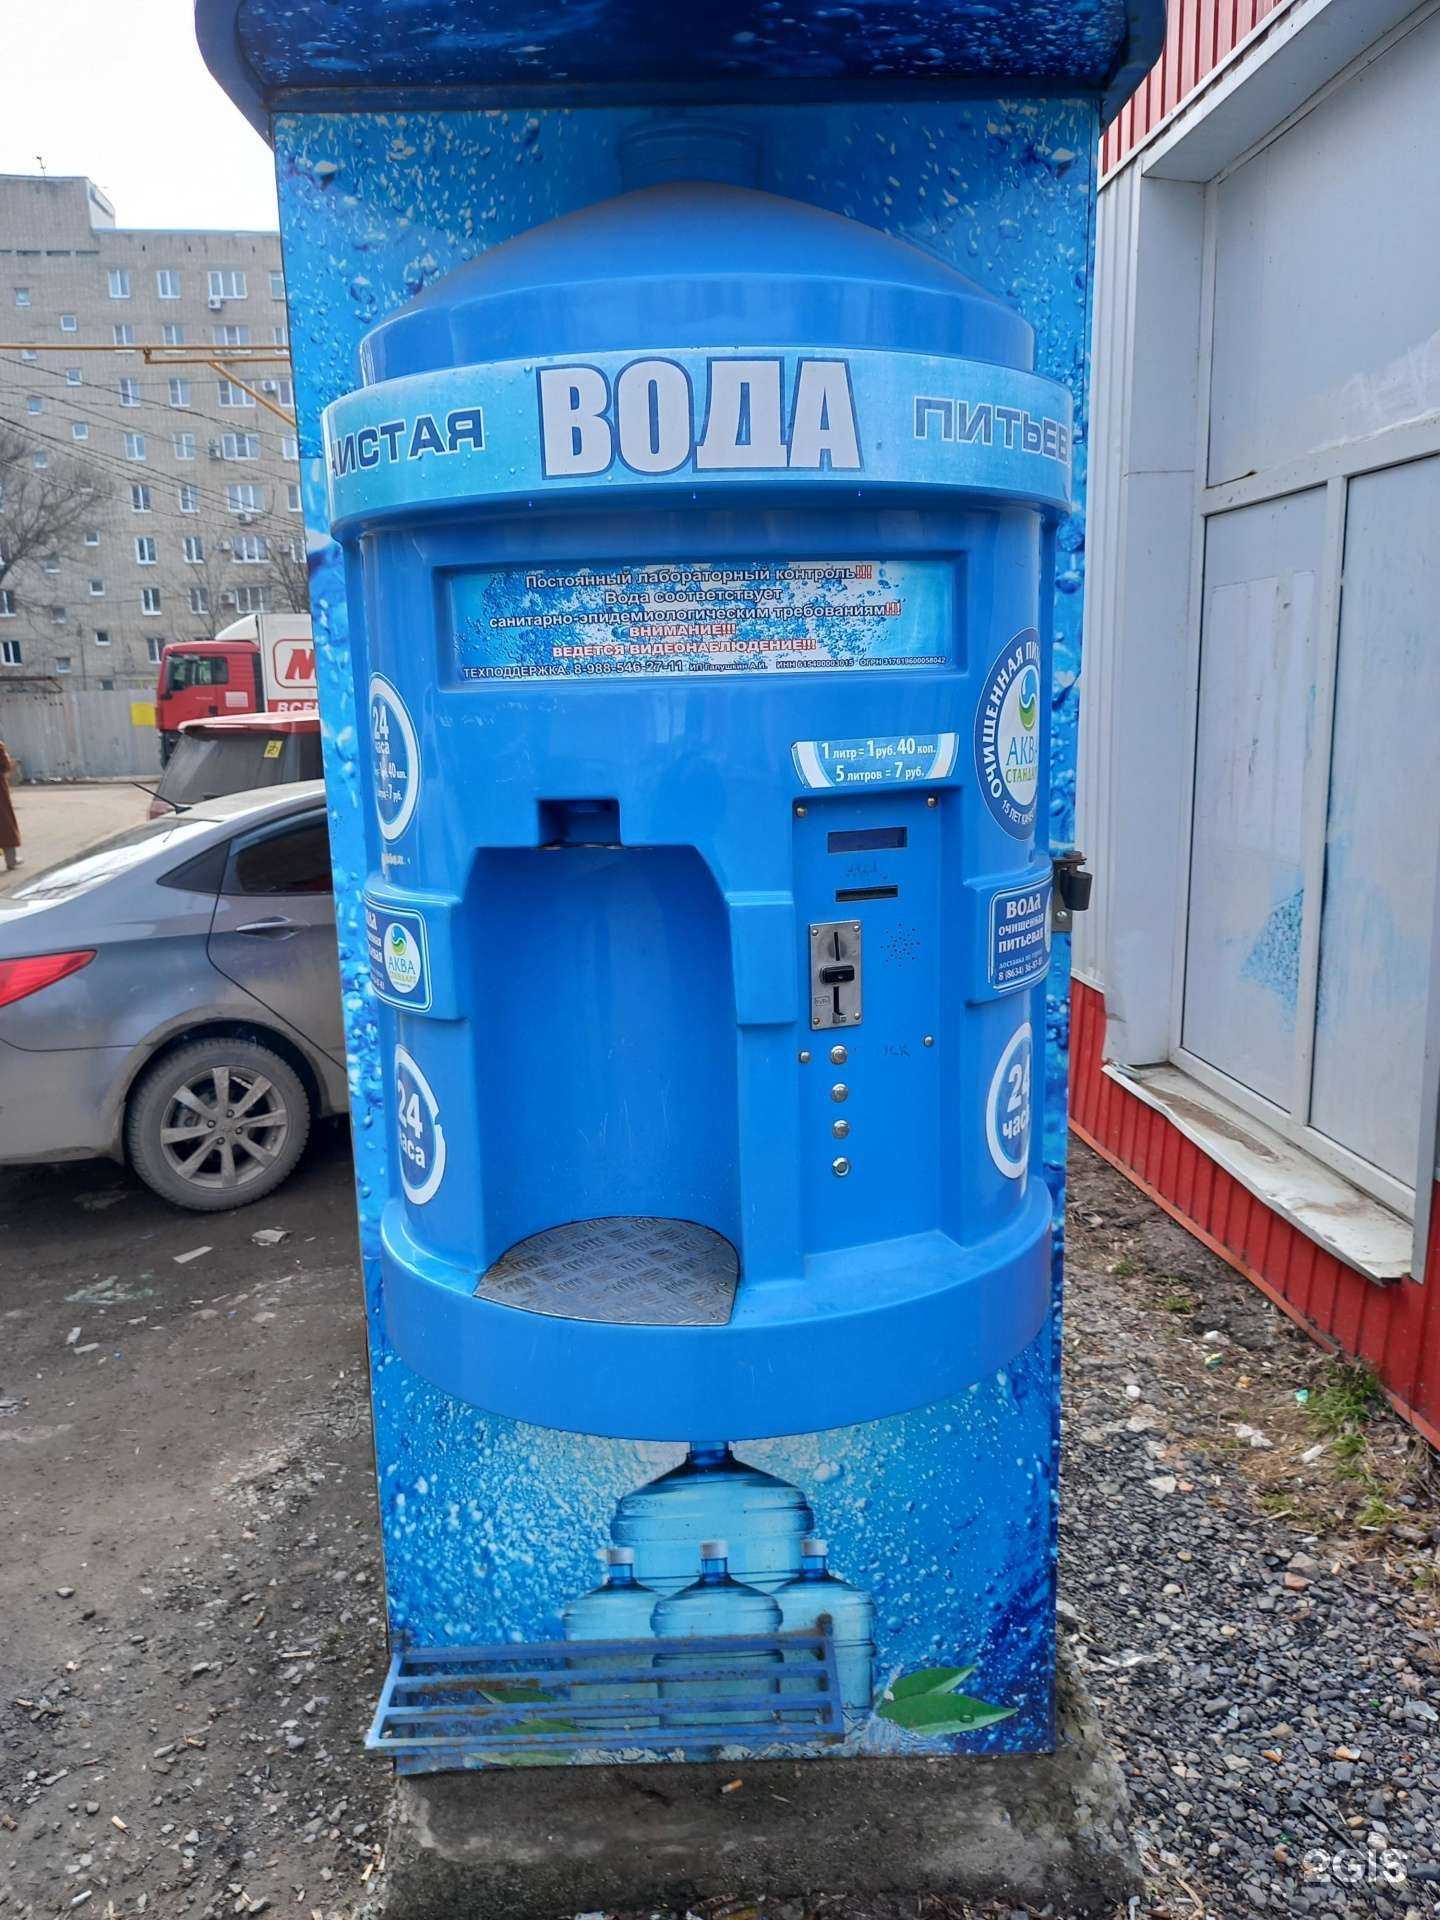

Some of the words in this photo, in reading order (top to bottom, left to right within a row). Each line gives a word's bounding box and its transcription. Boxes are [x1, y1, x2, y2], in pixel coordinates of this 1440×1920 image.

[536, 357, 864, 480] ВОДА
[526, 571, 632, 589] Постоянный
[637, 567, 770, 585] лабораторный
[776, 565, 872, 584] контроль!!!
[605, 591, 649, 605] Вода
[654, 588, 782, 604] соответствует
[489, 608, 770, 628] санитарно-эпидемиологическим
[774, 602, 901, 619] требованиям!!!
[629, 624, 736, 638] ВНИМАНИЕ!!!
[552, 644, 625, 658] ВЕДЕТСЯ
[629, 639, 816, 656] ВИДЕОНАБЛЮДЕНИЕ!!!
[776, 660, 796, 669] ИНН
[859, 658, 881, 667] ОГРН
[821, 742, 830, 760] 1
[898, 737, 915, 754] 40
[918, 745, 936, 755] коп.
[835, 764, 845, 782] 5
[847, 768, 882, 783] литров
[894, 761, 904, 778] 7
[905, 767, 925, 780] руб.
[400, 1134, 426, 1169] аса
